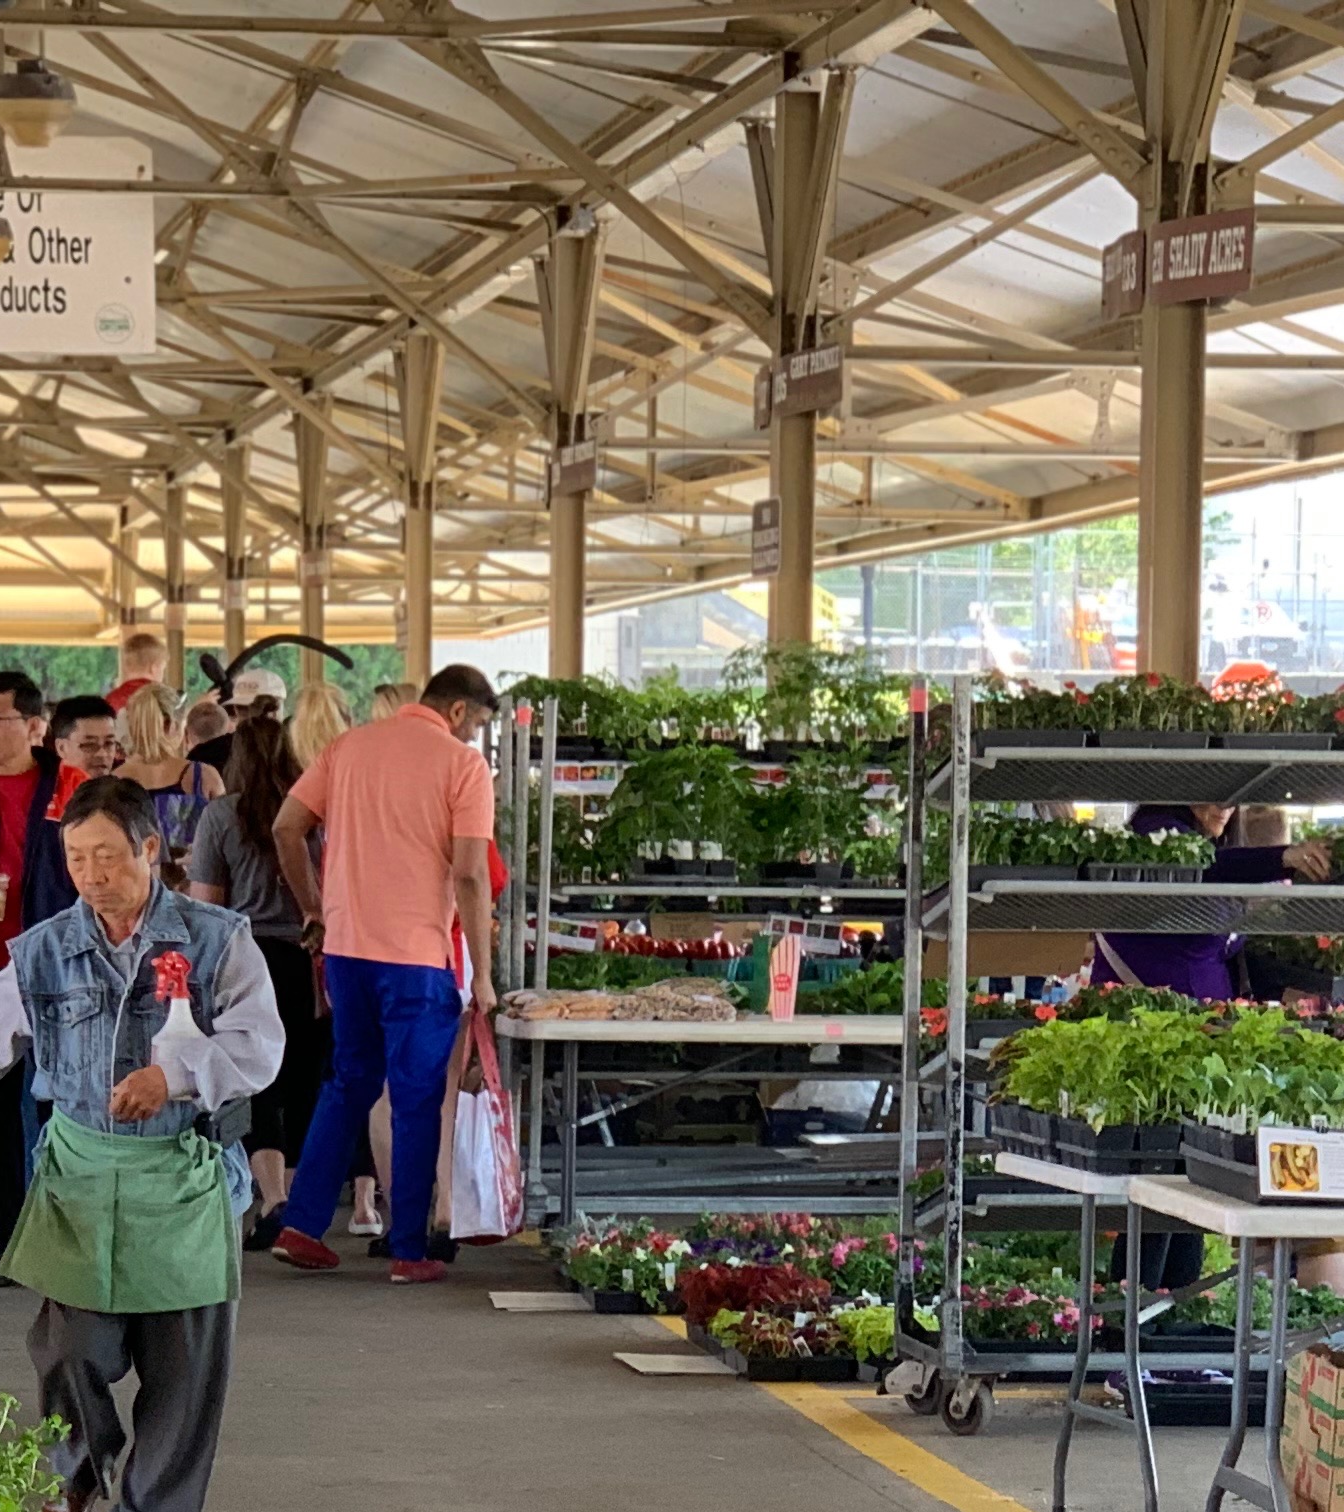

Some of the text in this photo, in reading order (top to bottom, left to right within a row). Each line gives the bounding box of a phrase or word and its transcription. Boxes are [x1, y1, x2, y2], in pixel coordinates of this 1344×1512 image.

[28, 226, 93, 265] Other
[1169, 231, 1208, 281] SHADY
[1208, 225, 1246, 275] ACRES
